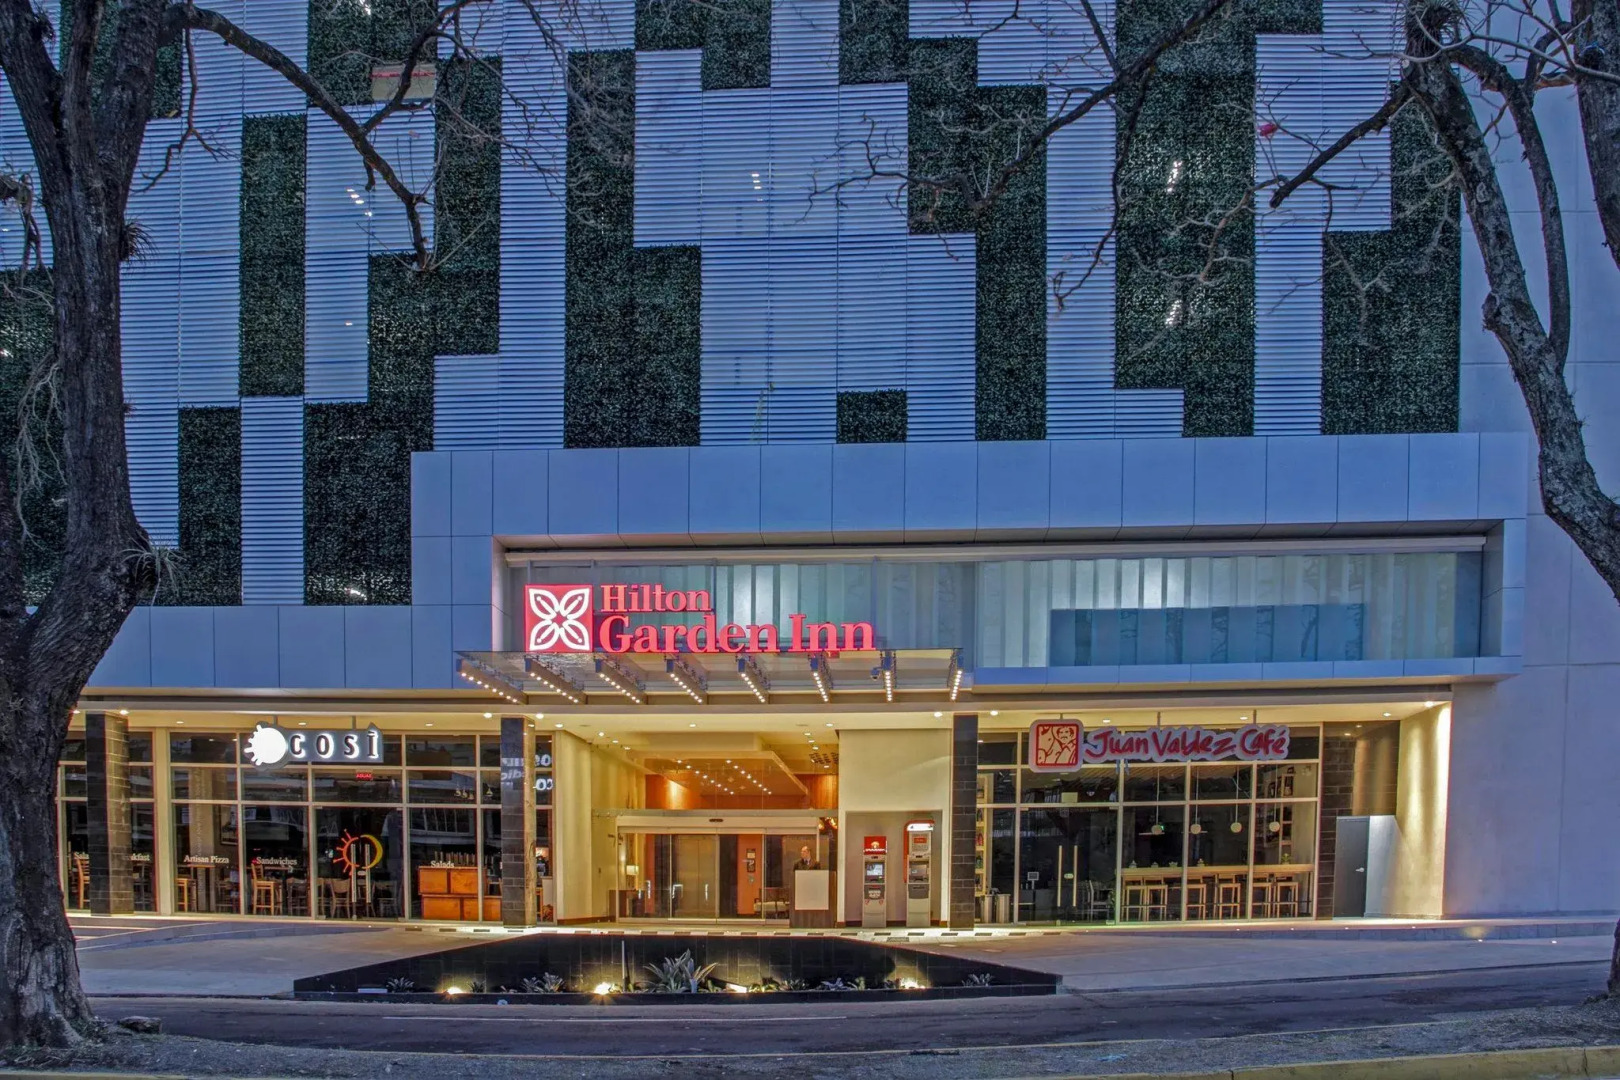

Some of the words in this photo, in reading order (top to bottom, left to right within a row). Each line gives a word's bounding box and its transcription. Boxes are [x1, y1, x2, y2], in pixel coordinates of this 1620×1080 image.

[600, 584, 712, 612] Hilton
[599, 614, 780, 653] Garden
[788, 614, 876, 653] Inn
[1085, 730, 1149, 756] Juan
[1151, 729, 1237, 756] Valdez
[1240, 728, 1287, 756] Café
[184, 854, 210, 863] Artisan
[210, 855, 230, 864] Pizza
[256, 856, 298, 866] Sandwiches
[430, 860, 455, 868] Salads
